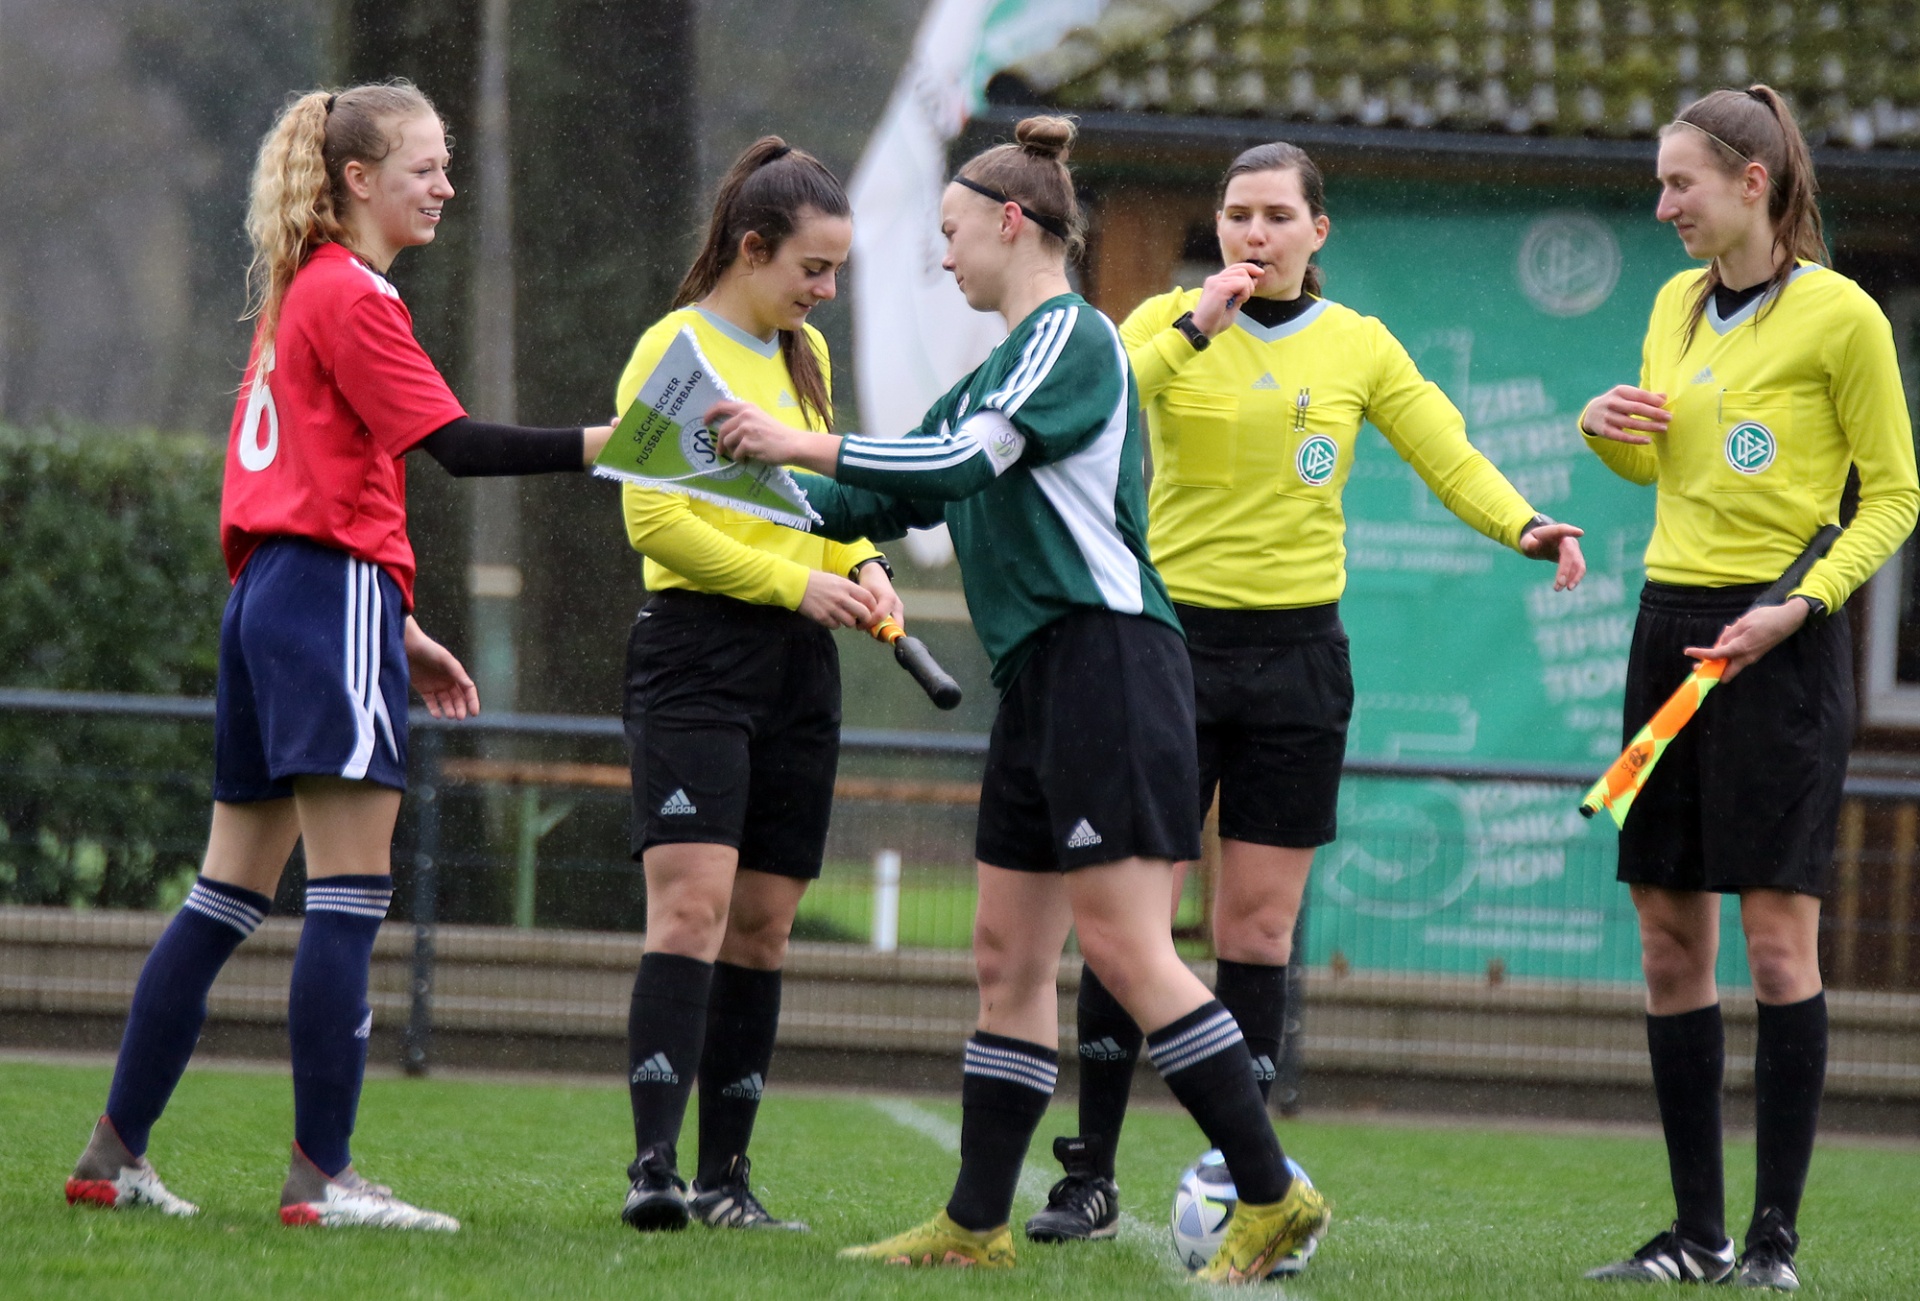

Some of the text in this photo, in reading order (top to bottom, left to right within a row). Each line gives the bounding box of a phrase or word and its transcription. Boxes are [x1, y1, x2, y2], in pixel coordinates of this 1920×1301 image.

[239, 342, 279, 472] 6
[632, 377, 681, 445] SÄCHSISCHER
[635, 369, 703, 466] FUSSBALL-VERBAND
[660, 804, 697, 815] adidas
[1067, 835, 1103, 848] adidas
[632, 1070, 679, 1084] adidas
[722, 1085, 762, 1100] adida
